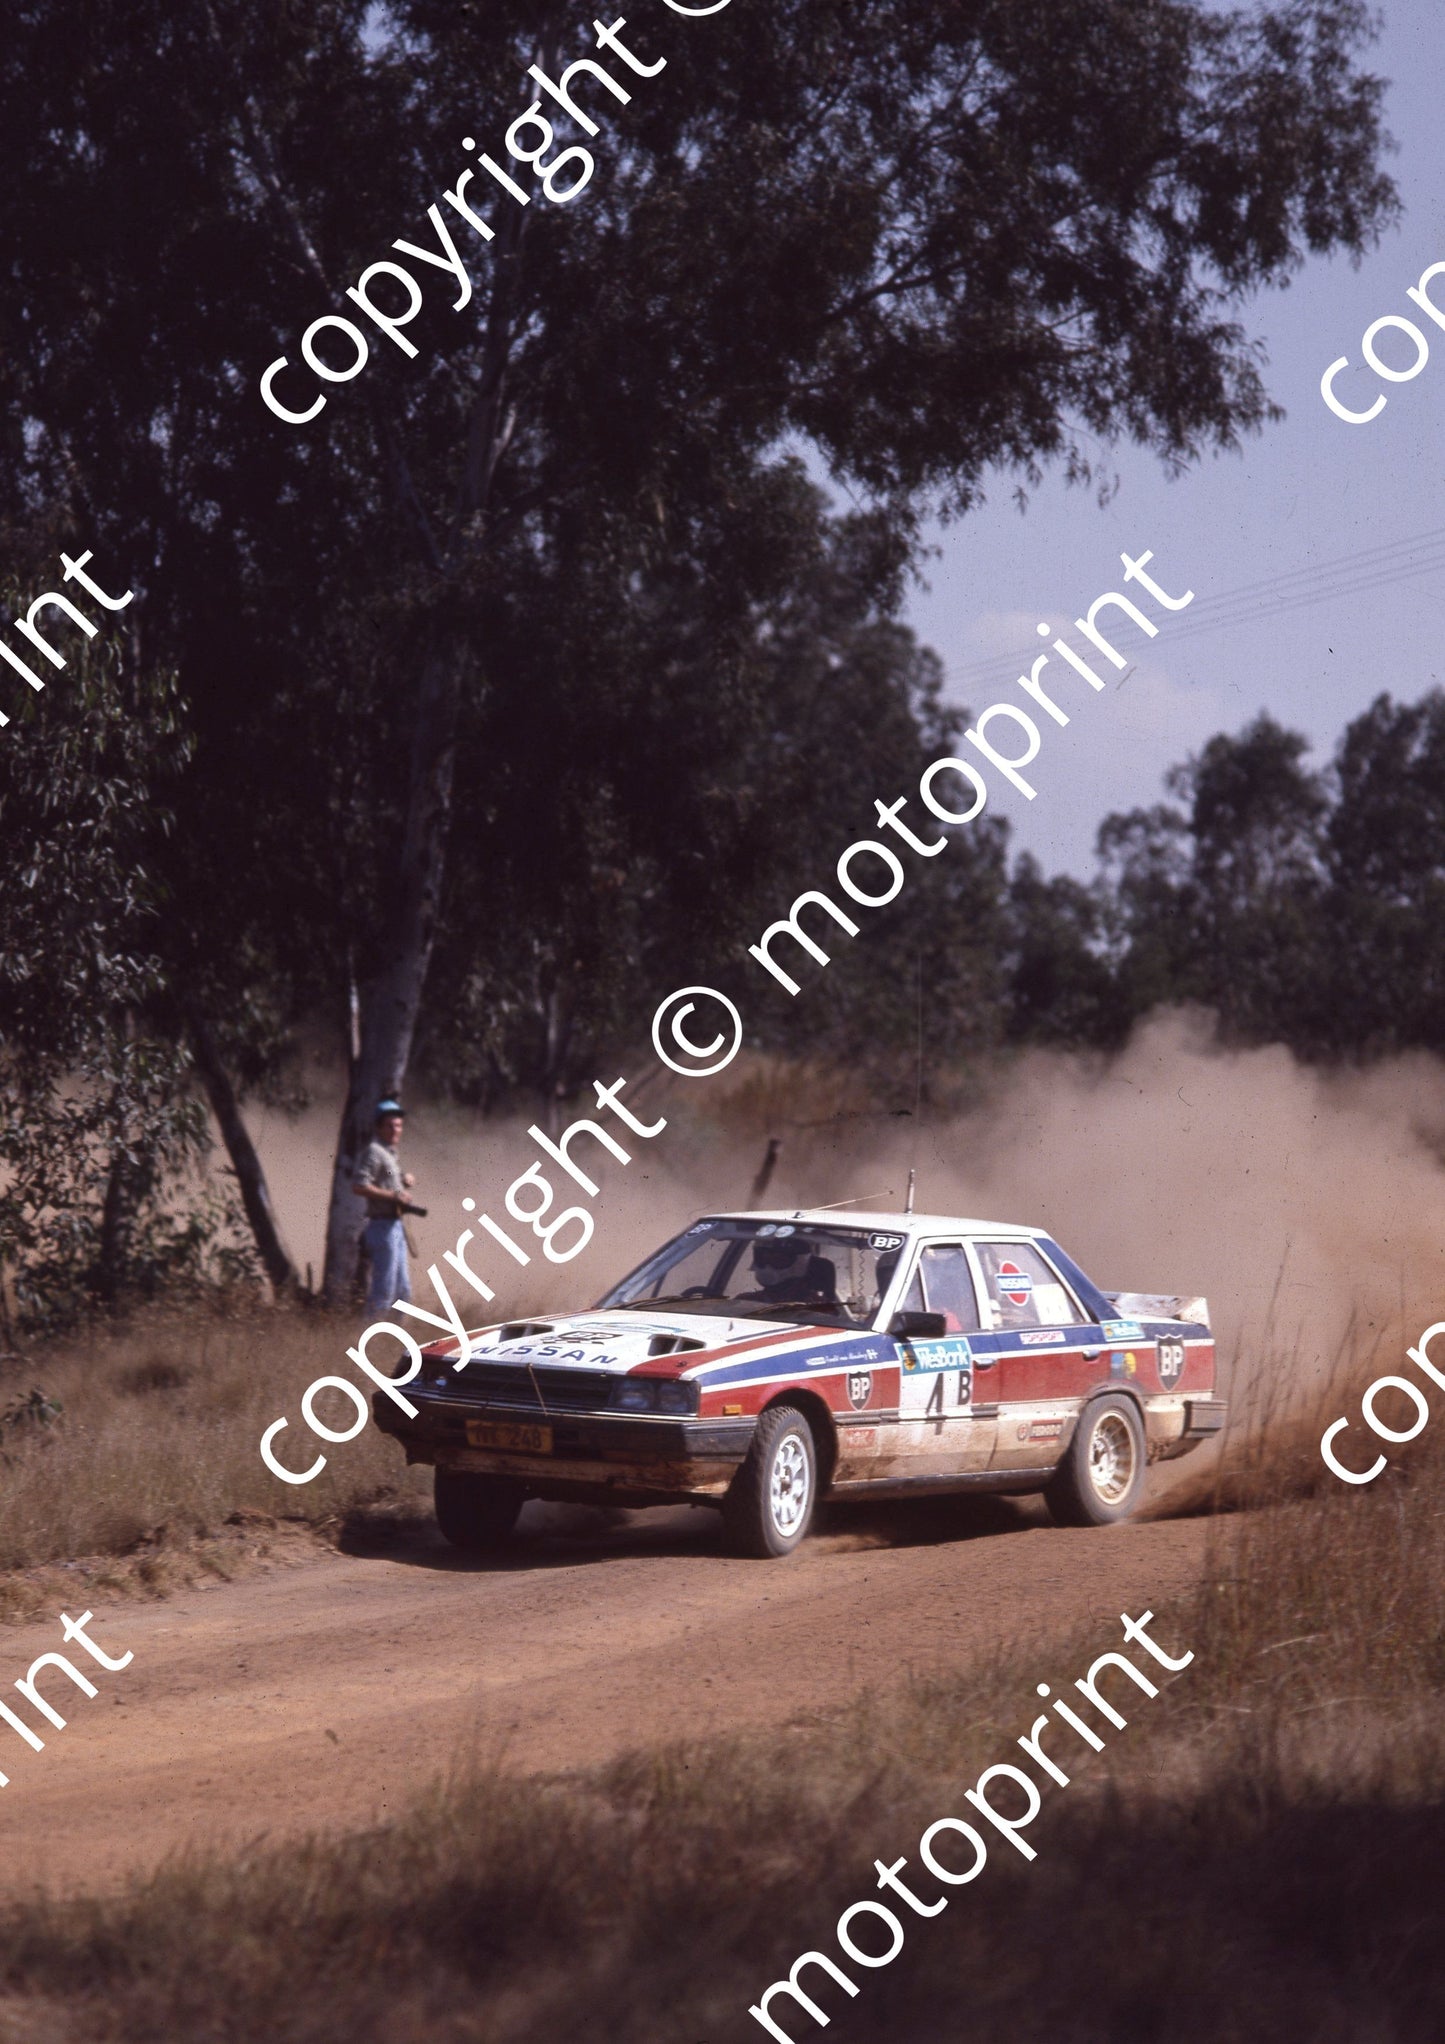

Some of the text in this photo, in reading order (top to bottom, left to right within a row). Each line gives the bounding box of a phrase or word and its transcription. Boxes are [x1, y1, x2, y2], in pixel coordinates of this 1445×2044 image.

[871, 1236, 901, 1249] BP
[472, 1344, 617, 1364] NISSAN
[914, 1344, 969, 1369] WesBank
[1160, 1345, 1183, 1376] BP
[850, 1377, 871, 1400] BP
[925, 1370, 971, 1435] 4 B
